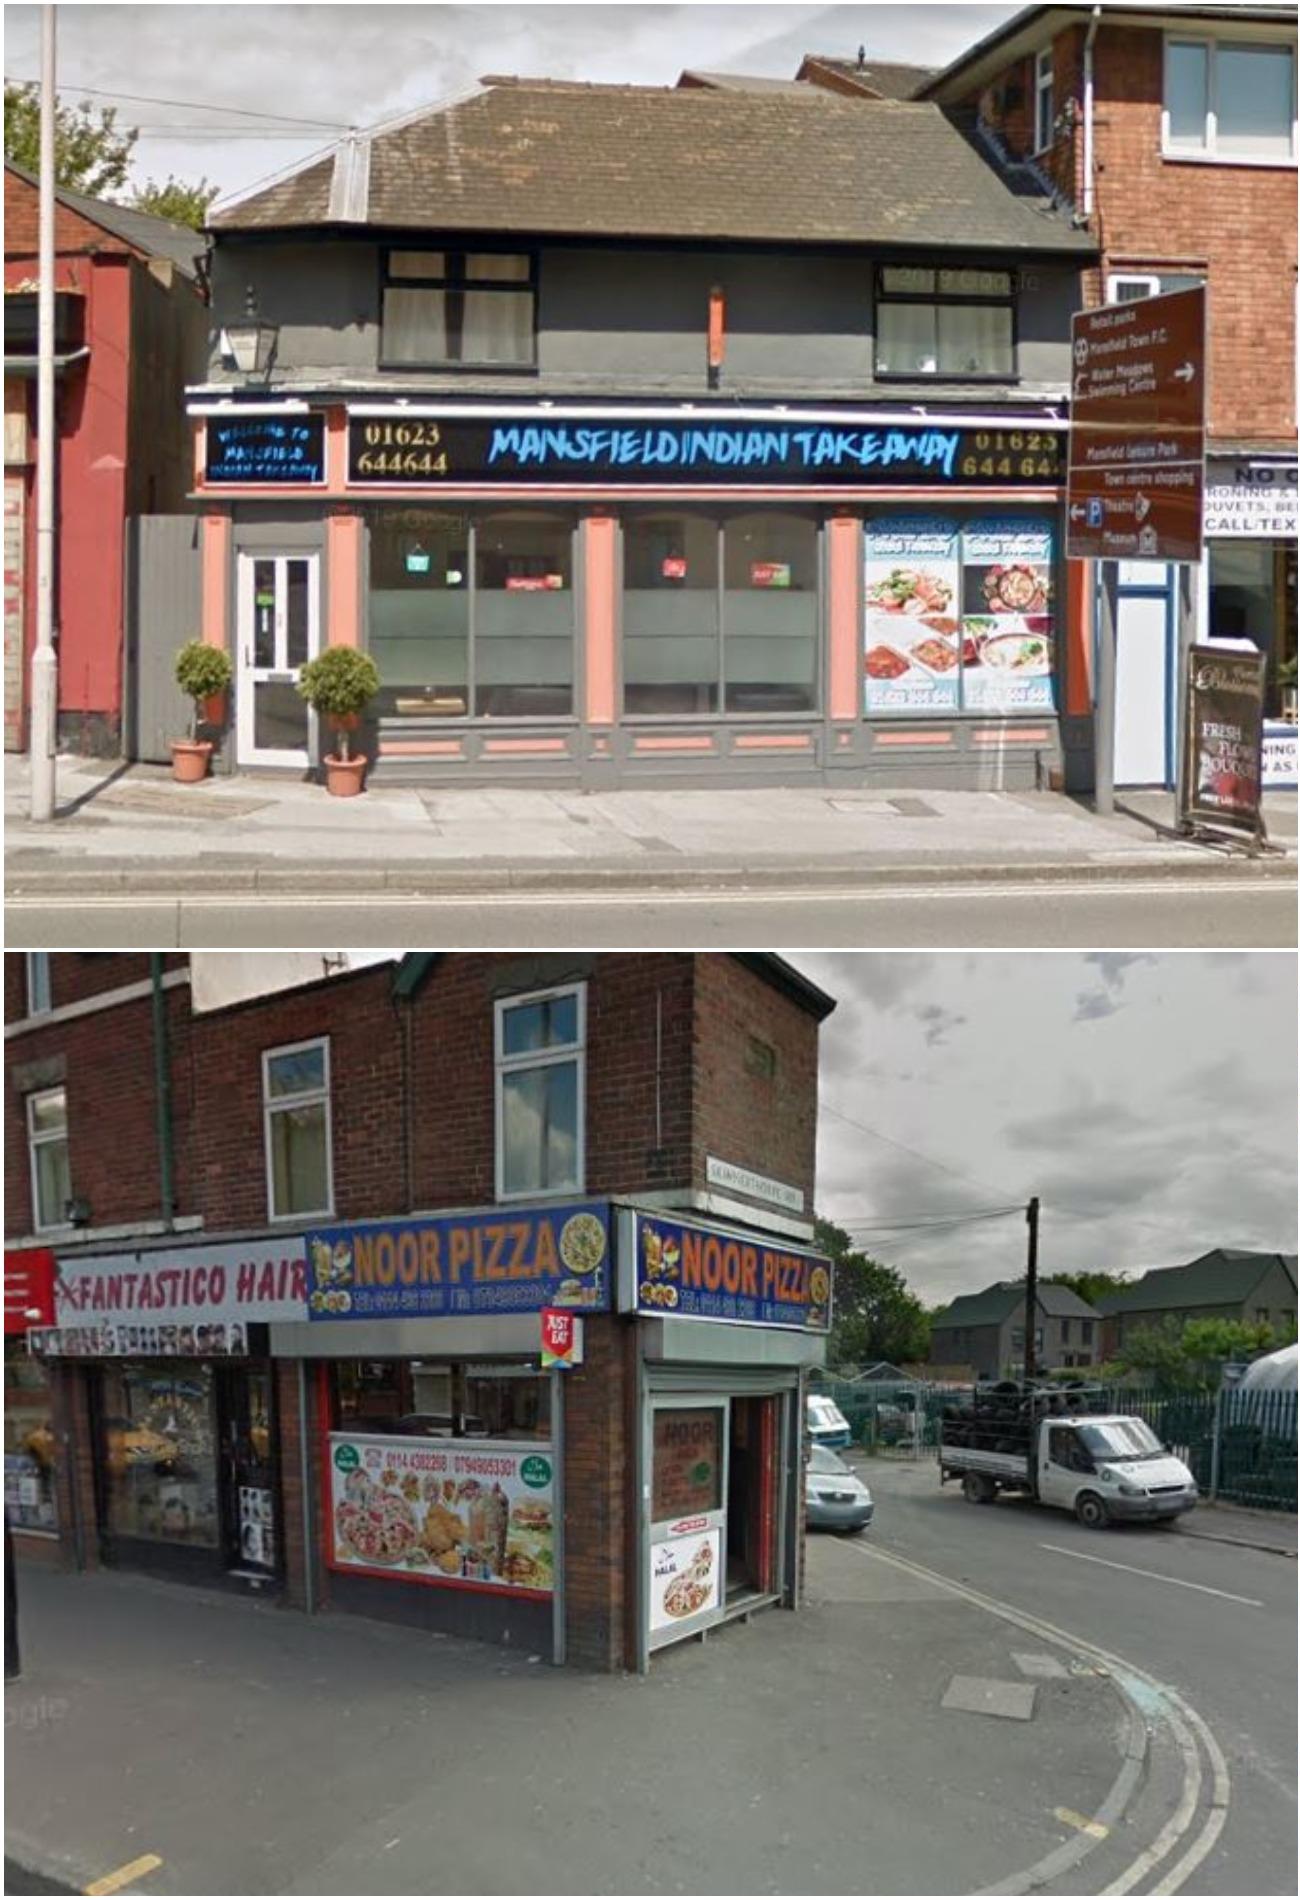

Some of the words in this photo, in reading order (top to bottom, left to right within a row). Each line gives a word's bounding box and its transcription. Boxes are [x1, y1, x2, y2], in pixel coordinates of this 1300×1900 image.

[1090, 338, 1127, 355] Mansfield
[1128, 333, 1150, 349] Town
[1128, 378, 1156, 394] Centre
[364, 423, 440, 446] 01623
[487, 427, 679, 464] MANSFIELD
[680, 430, 789, 465] INDIAN
[793, 430, 959, 476] TAKEAWAY
[1086, 445, 1125, 460] Mansfield
[1126, 444, 1156, 459] Leisure
[1158, 441, 1178, 457] Park
[358, 453, 447, 476] 644644
[1105, 472, 1125, 486] Town
[1126, 474, 1153, 486] centre
[1155, 470, 1194, 488] shopping
[1235, 467, 1275, 483] NO
[1104, 498, 1135, 514] Theatre
[353, 1230, 442, 1285] NOOR
[450, 1218, 560, 1283] PIZZA
[682, 1232, 758, 1295] NOOR
[79, 1265, 226, 1311] FANTASTICO
[236, 1259, 307, 1304] HAIR
[548, 1314, 569, 1330] JUST
[551, 1331, 569, 1344] EAT
